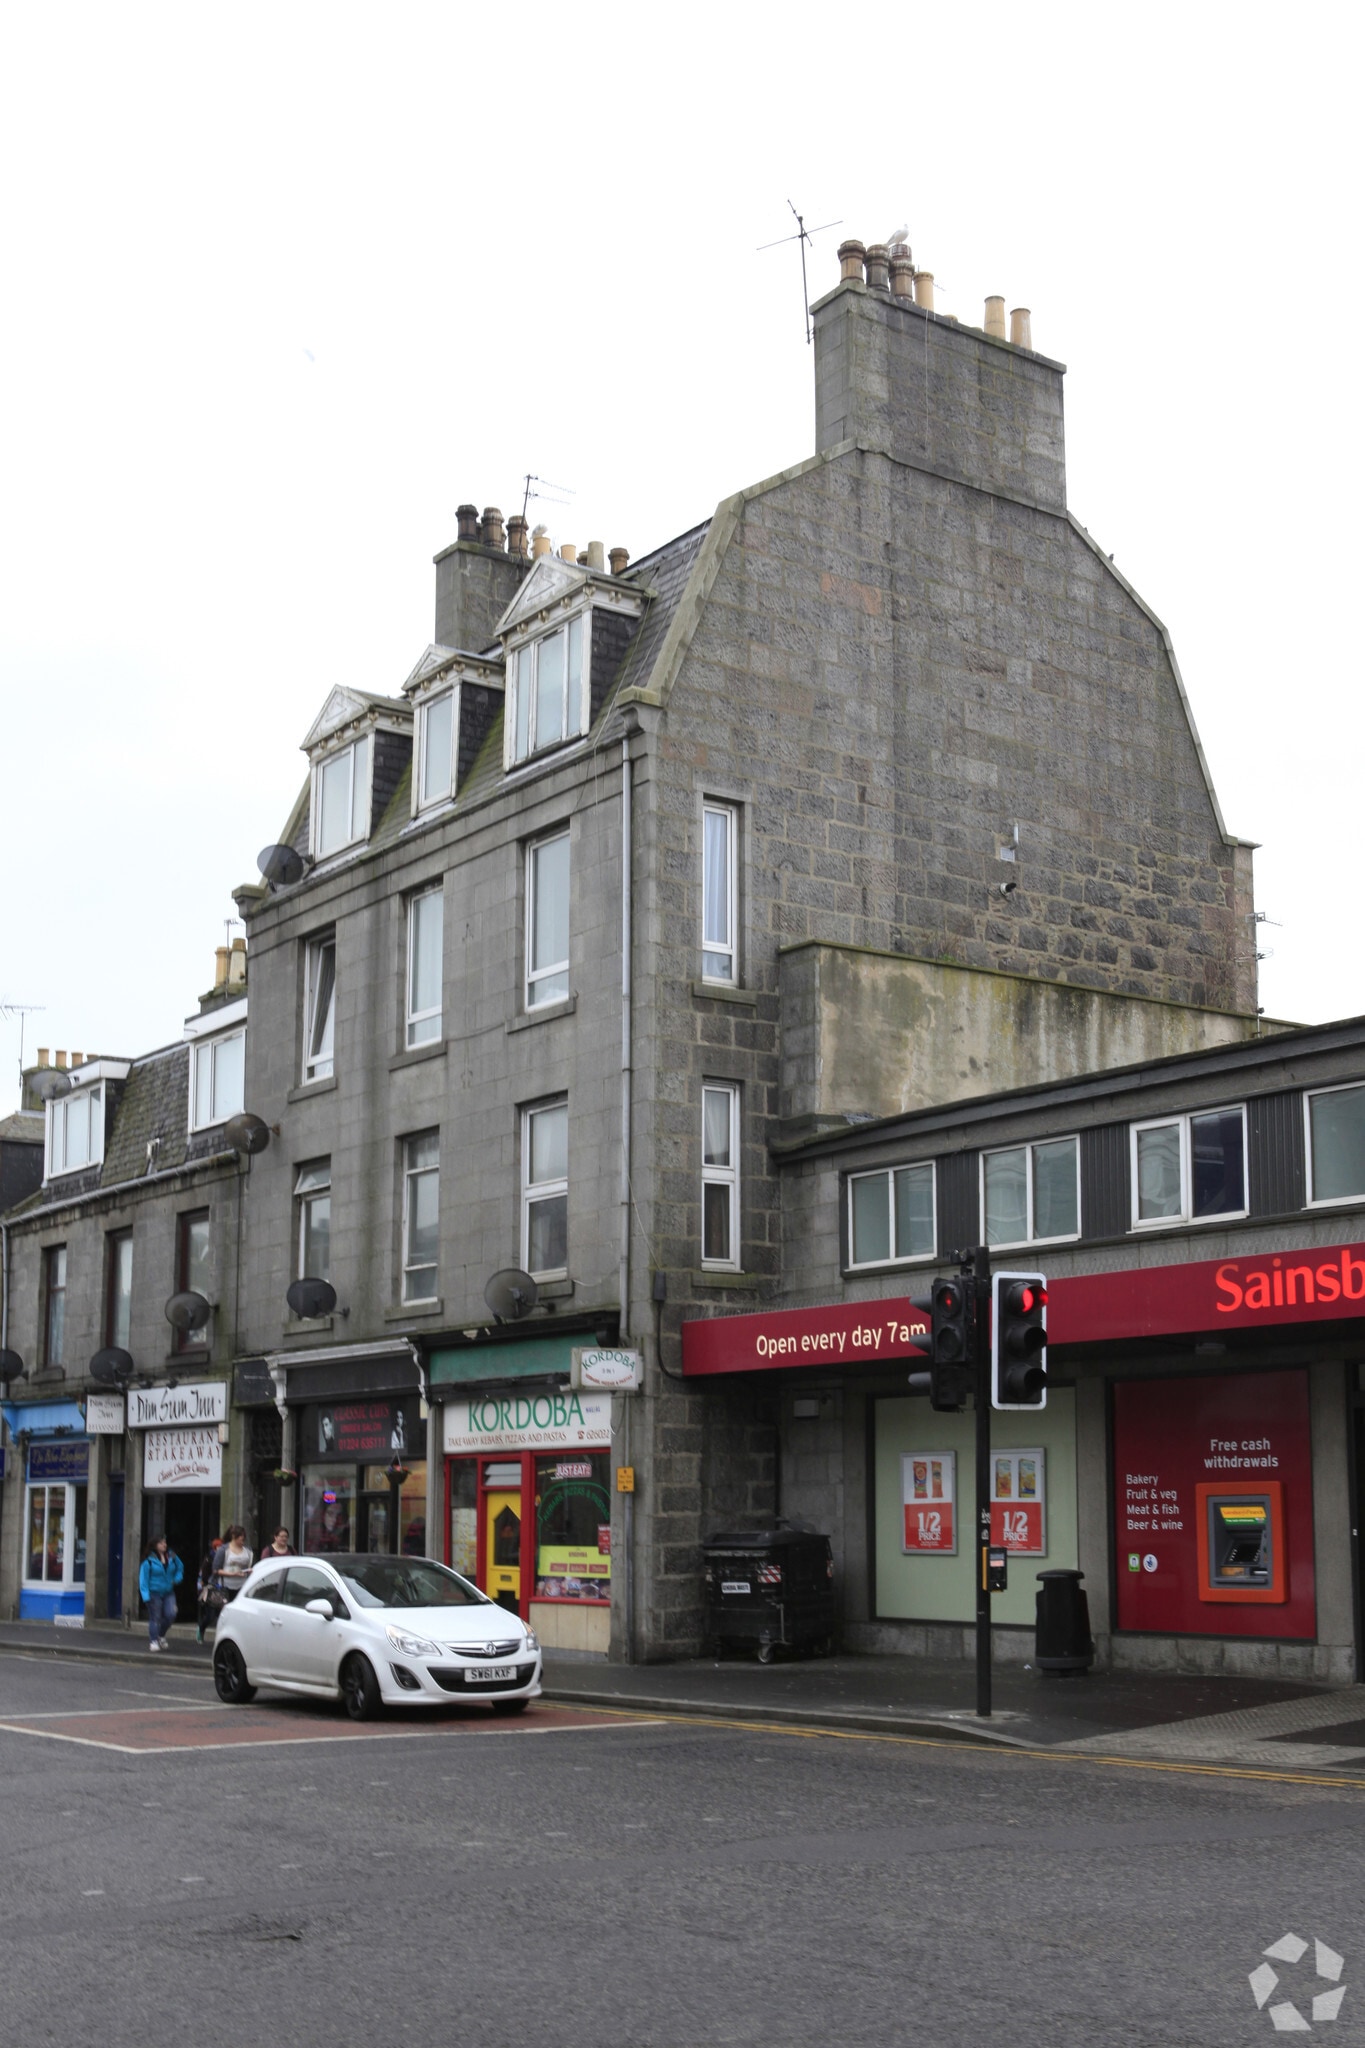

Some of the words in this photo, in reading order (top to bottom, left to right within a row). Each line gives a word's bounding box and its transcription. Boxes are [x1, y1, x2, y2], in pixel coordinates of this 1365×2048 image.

[1215, 1249, 1365, 1312] Sainsb
[756, 1335, 797, 1359] Open
[801, 1331, 846, 1353] every
[851, 1325, 882, 1350] day
[582, 1350, 635, 1371] KORDOBA
[137, 1395, 157, 1422] Dim
[160, 1387, 188, 1422] Sum
[189, 1389, 215, 1419] Inn
[468, 1393, 585, 1432] KORDOBA
[1210, 1439, 1238, 1451] Free
[1241, 1438, 1271, 1451] cash
[1204, 1455, 1279, 1468] withdrawals
[1126, 1474, 1159, 1486] Bakery
[1126, 1489, 1148, 1500] Fruit
[1151, 1489, 1158, 1500] &
[1160, 1491, 1177, 1501] veg
[1127, 1504, 1150, 1515] Meat
[1152, 1504, 1160, 1515] &
[1162, 1503, 1180, 1515] fish
[918, 1511, 941, 1532] 1/2
[1003, 1511, 1028, 1532] 1/2
[1127, 1519, 1149, 1530] Beer
[1151, 1519, 1159, 1530] &
[1161, 1519, 1183, 1530] wine
[918, 1531, 942, 1541] PRICE
[1003, 1531, 1028, 1541] PRICE
